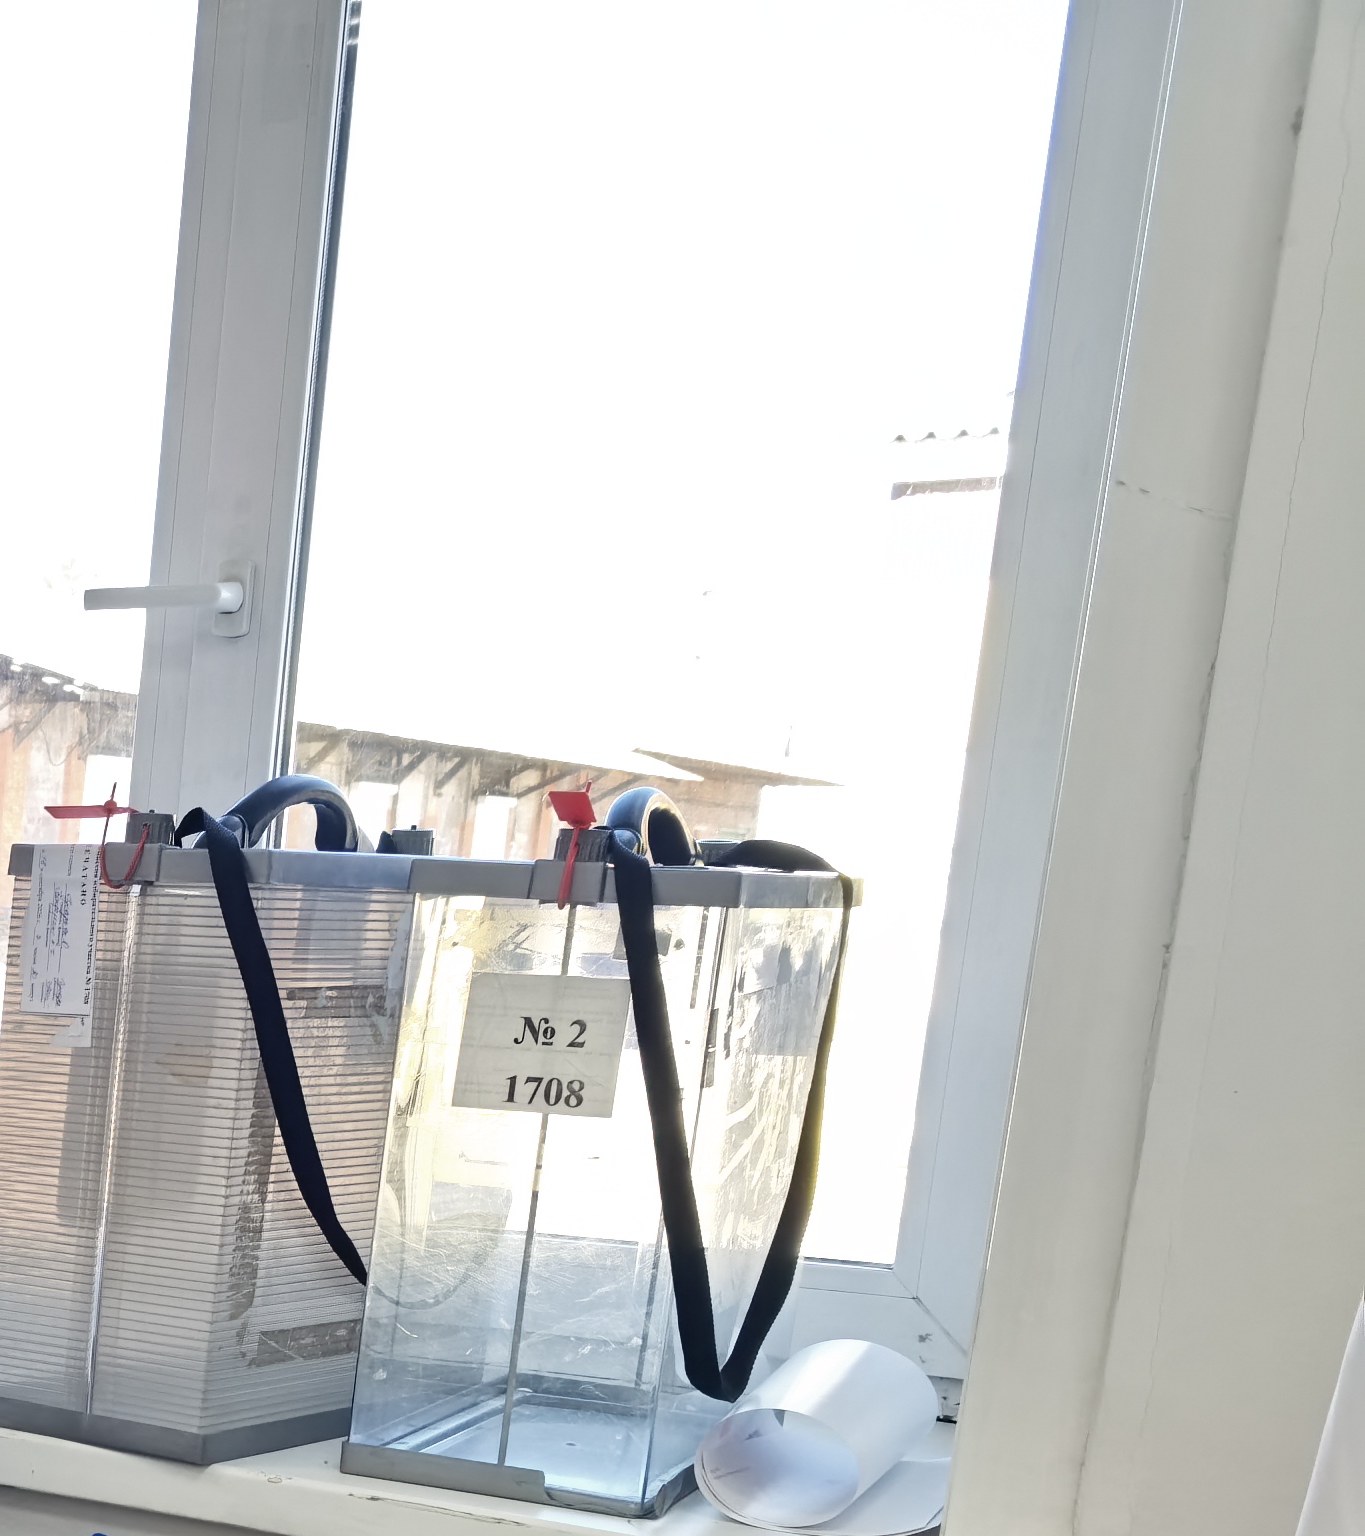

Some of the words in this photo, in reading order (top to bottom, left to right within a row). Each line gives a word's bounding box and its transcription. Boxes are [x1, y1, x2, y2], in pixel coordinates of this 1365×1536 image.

[513, 1016, 556, 1046] №
[566, 1019, 587, 1049] 2
[502, 1075, 585, 1108] 1708
